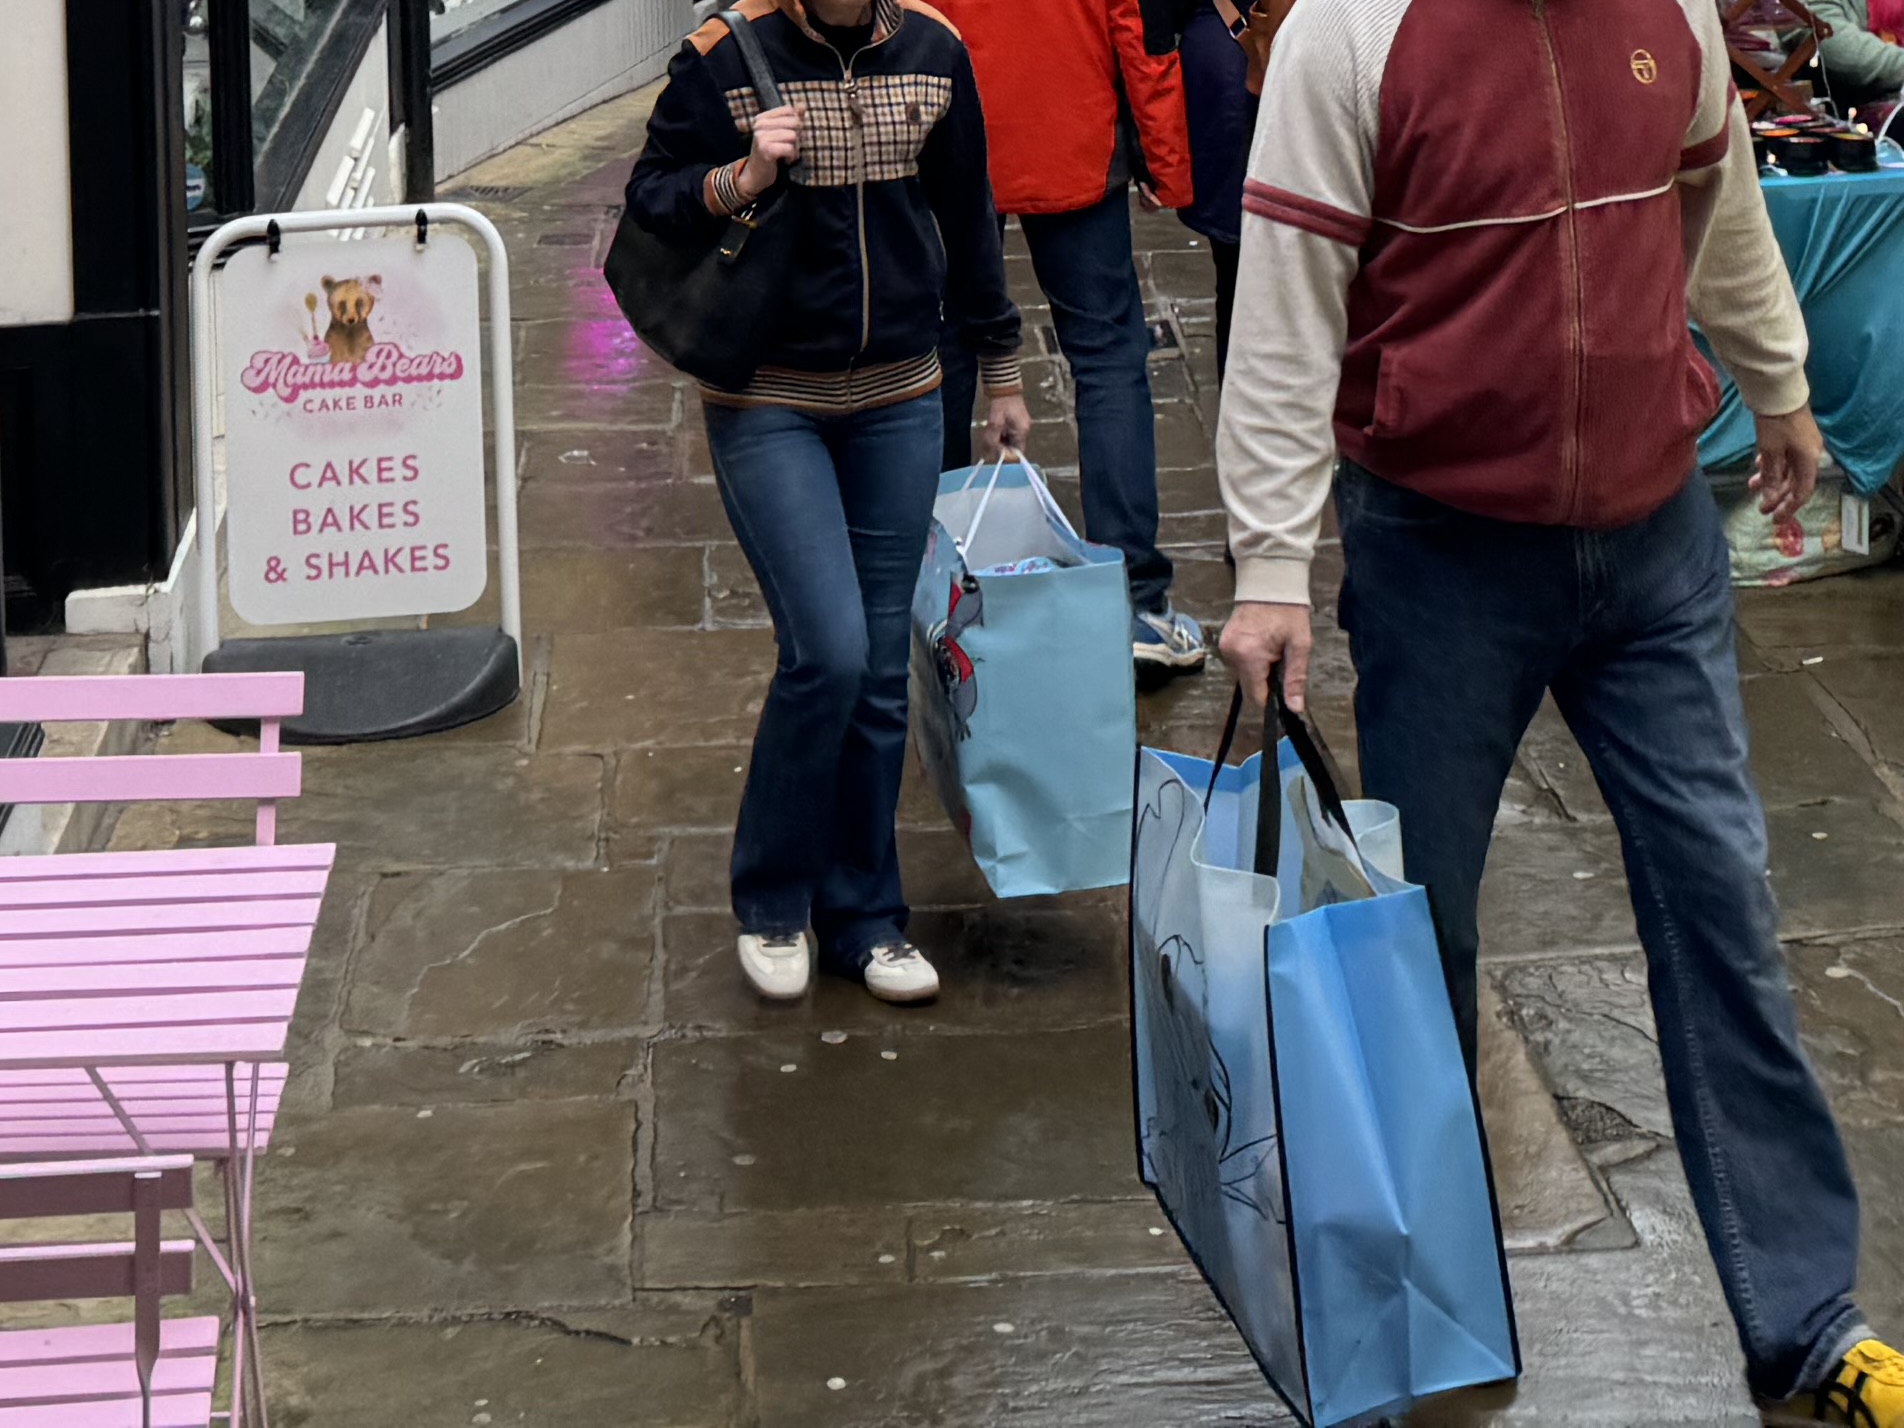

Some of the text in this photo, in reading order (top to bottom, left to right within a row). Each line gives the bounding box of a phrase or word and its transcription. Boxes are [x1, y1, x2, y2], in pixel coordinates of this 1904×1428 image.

[240, 342, 464, 404] Mama Bears
[303, 393, 404, 414] CAKE BAR
[289, 454, 420, 491] CAKES
[292, 500, 421, 536] BAKES
[264, 543, 451, 584] & SHAKES
